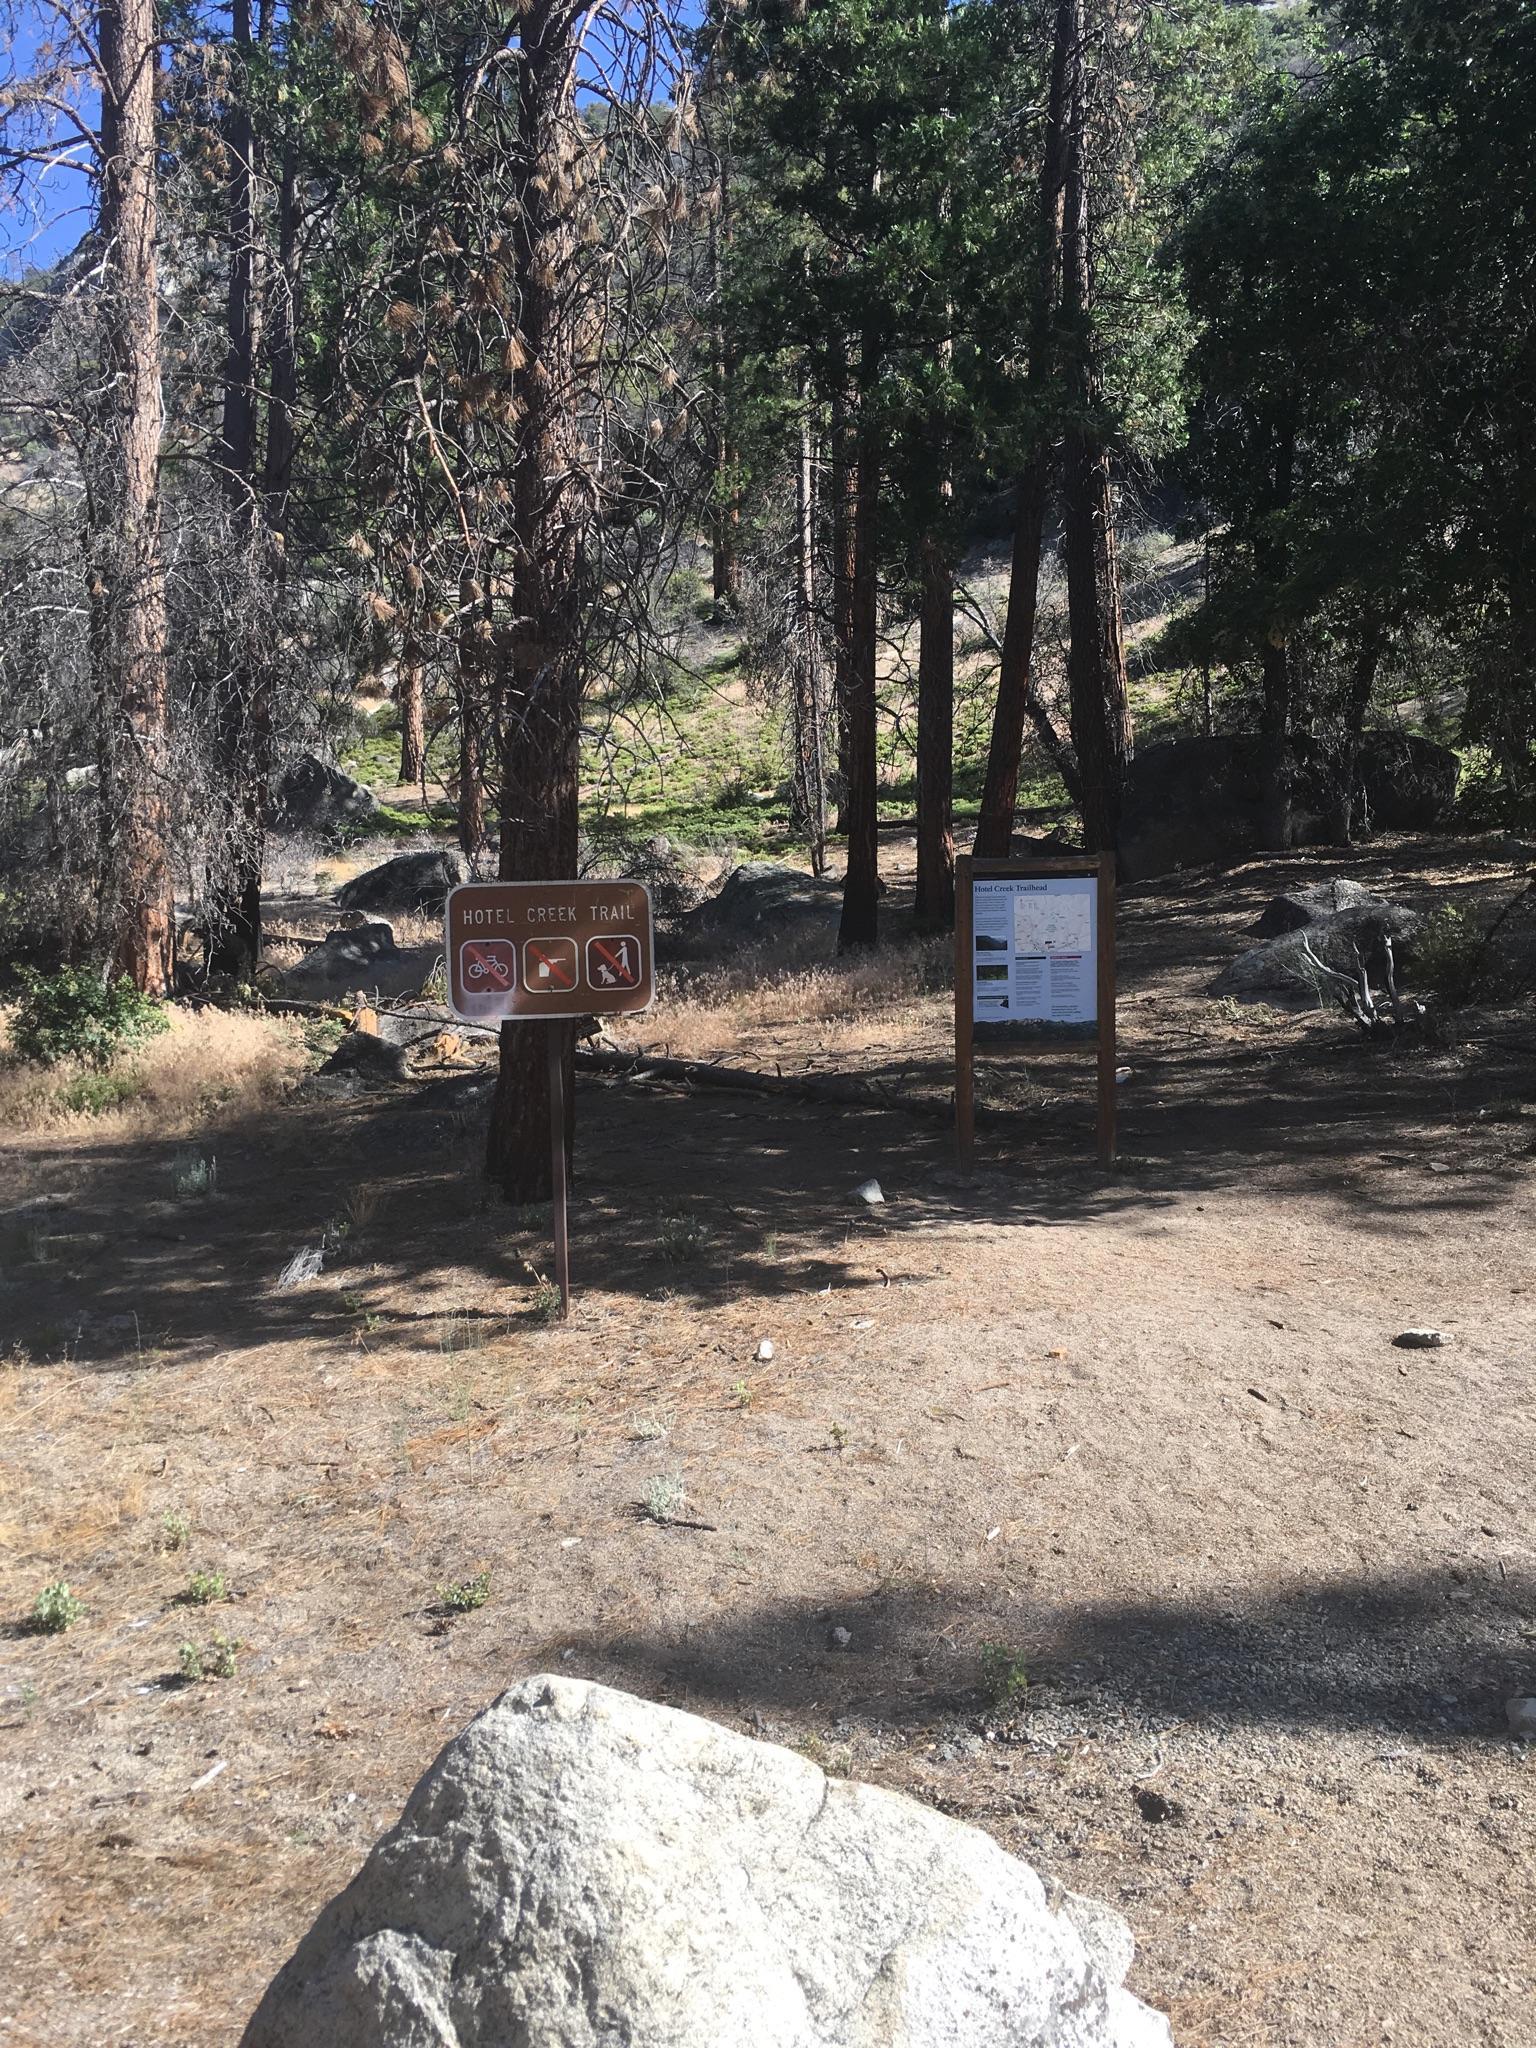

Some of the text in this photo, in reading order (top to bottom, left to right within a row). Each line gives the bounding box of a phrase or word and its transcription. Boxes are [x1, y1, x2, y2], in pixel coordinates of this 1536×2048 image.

[974, 885, 992, 893] Hotel
[1016, 884, 1048, 892] Trailhead
[464, 905, 635, 925] HOTEL CREEK TRAIL
